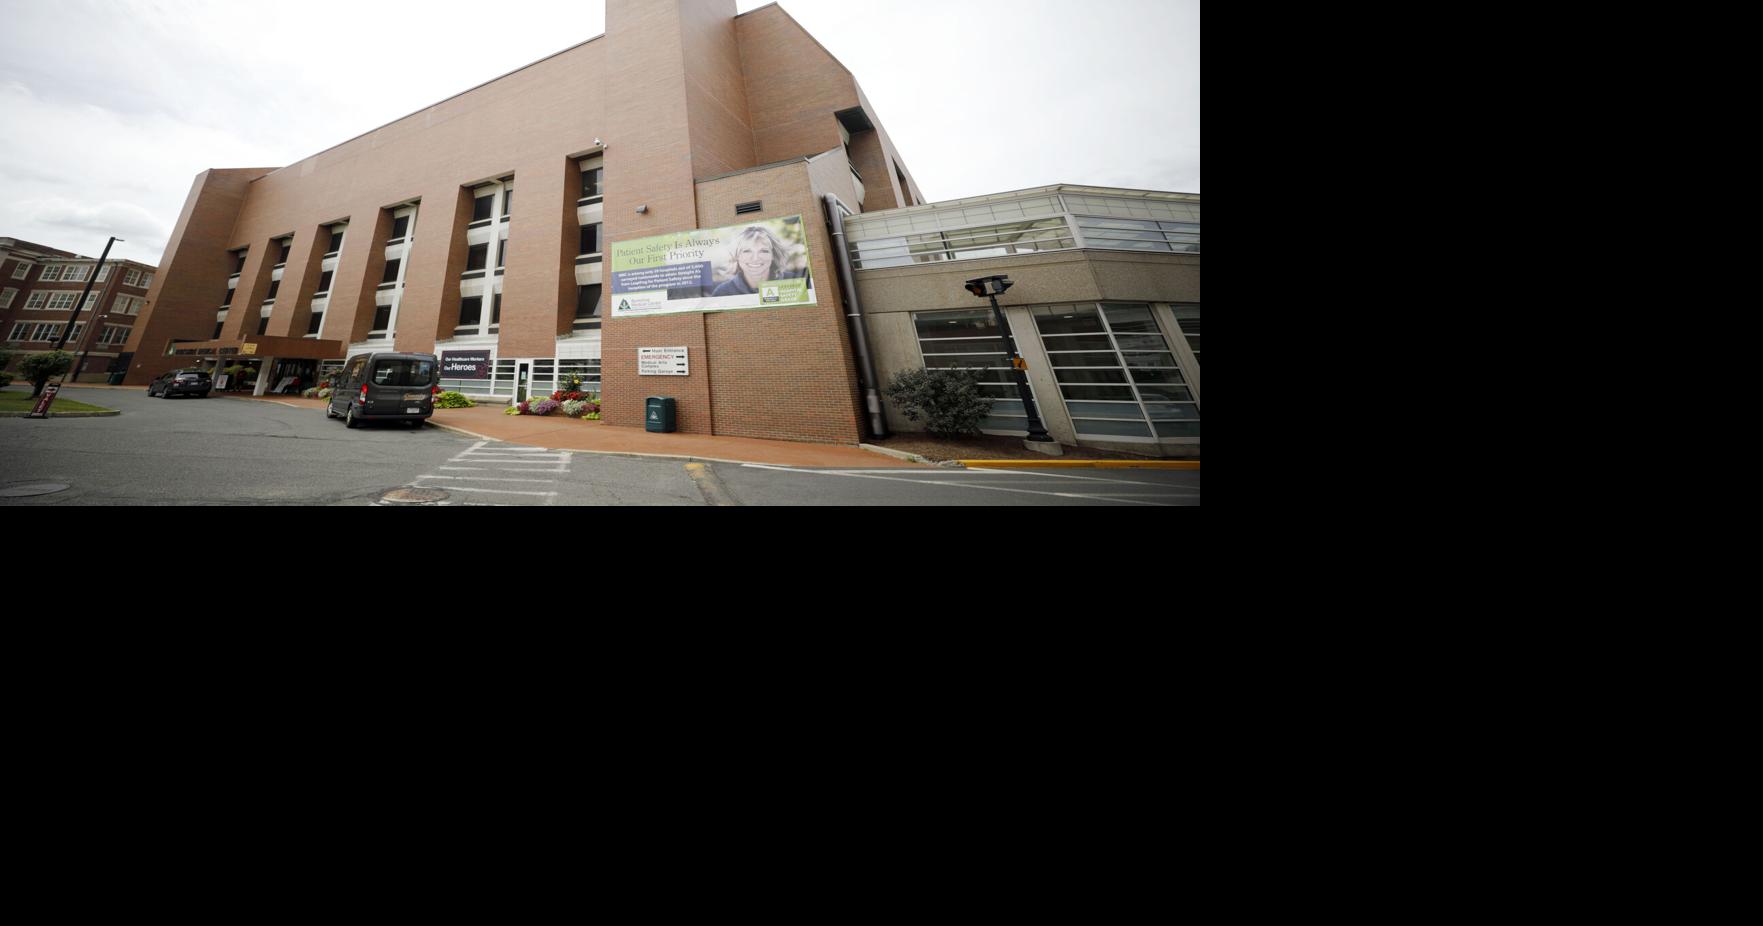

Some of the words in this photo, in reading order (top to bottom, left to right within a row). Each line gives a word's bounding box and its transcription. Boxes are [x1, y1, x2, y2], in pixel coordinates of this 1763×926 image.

[617, 248, 643, 257] Patient
[646, 243, 672, 253] Safety
[675, 241, 683, 249] Is
[686, 238, 720, 248] Always
[629, 257, 644, 265] Our
[648, 255, 666, 264] First
[670, 250, 704, 259] Priority
